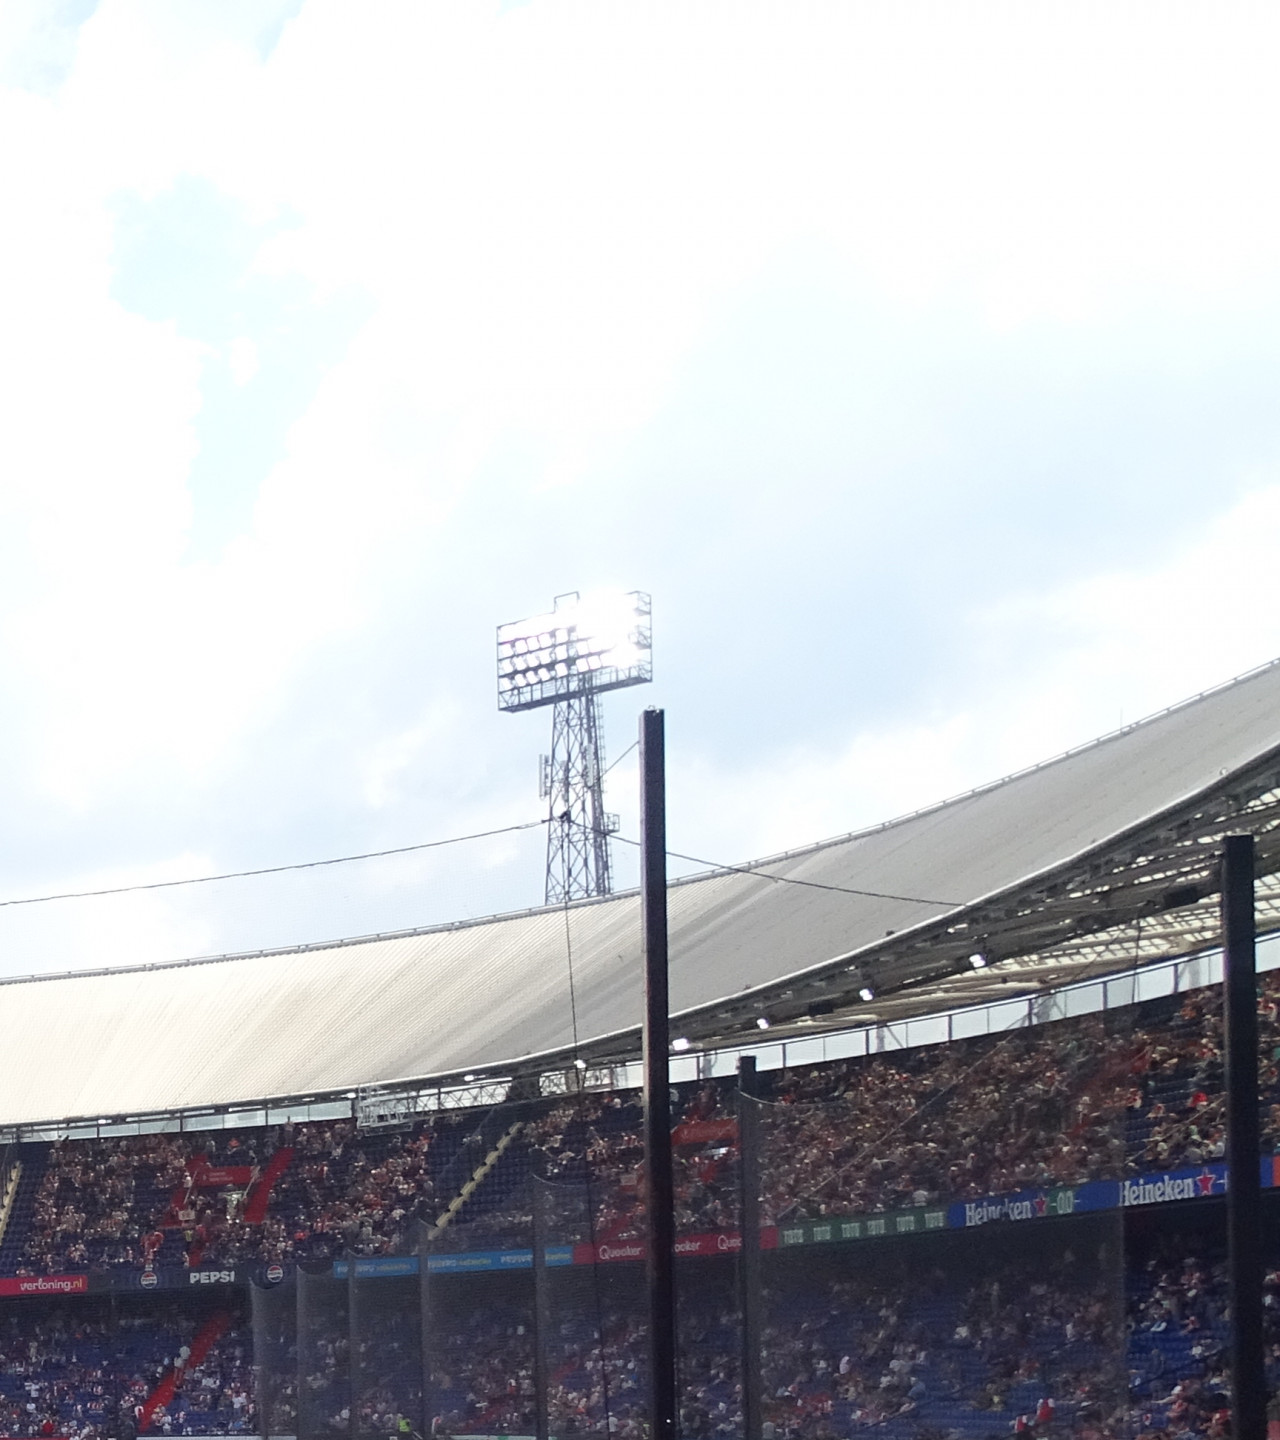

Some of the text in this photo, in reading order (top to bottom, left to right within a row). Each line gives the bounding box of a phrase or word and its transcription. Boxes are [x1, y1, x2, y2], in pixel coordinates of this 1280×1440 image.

[1120, 1176, 1195, 1206] Heineken
[190, 1271, 235, 1284] PEPSI
[20, 1279, 83, 1292] verloning.nl
